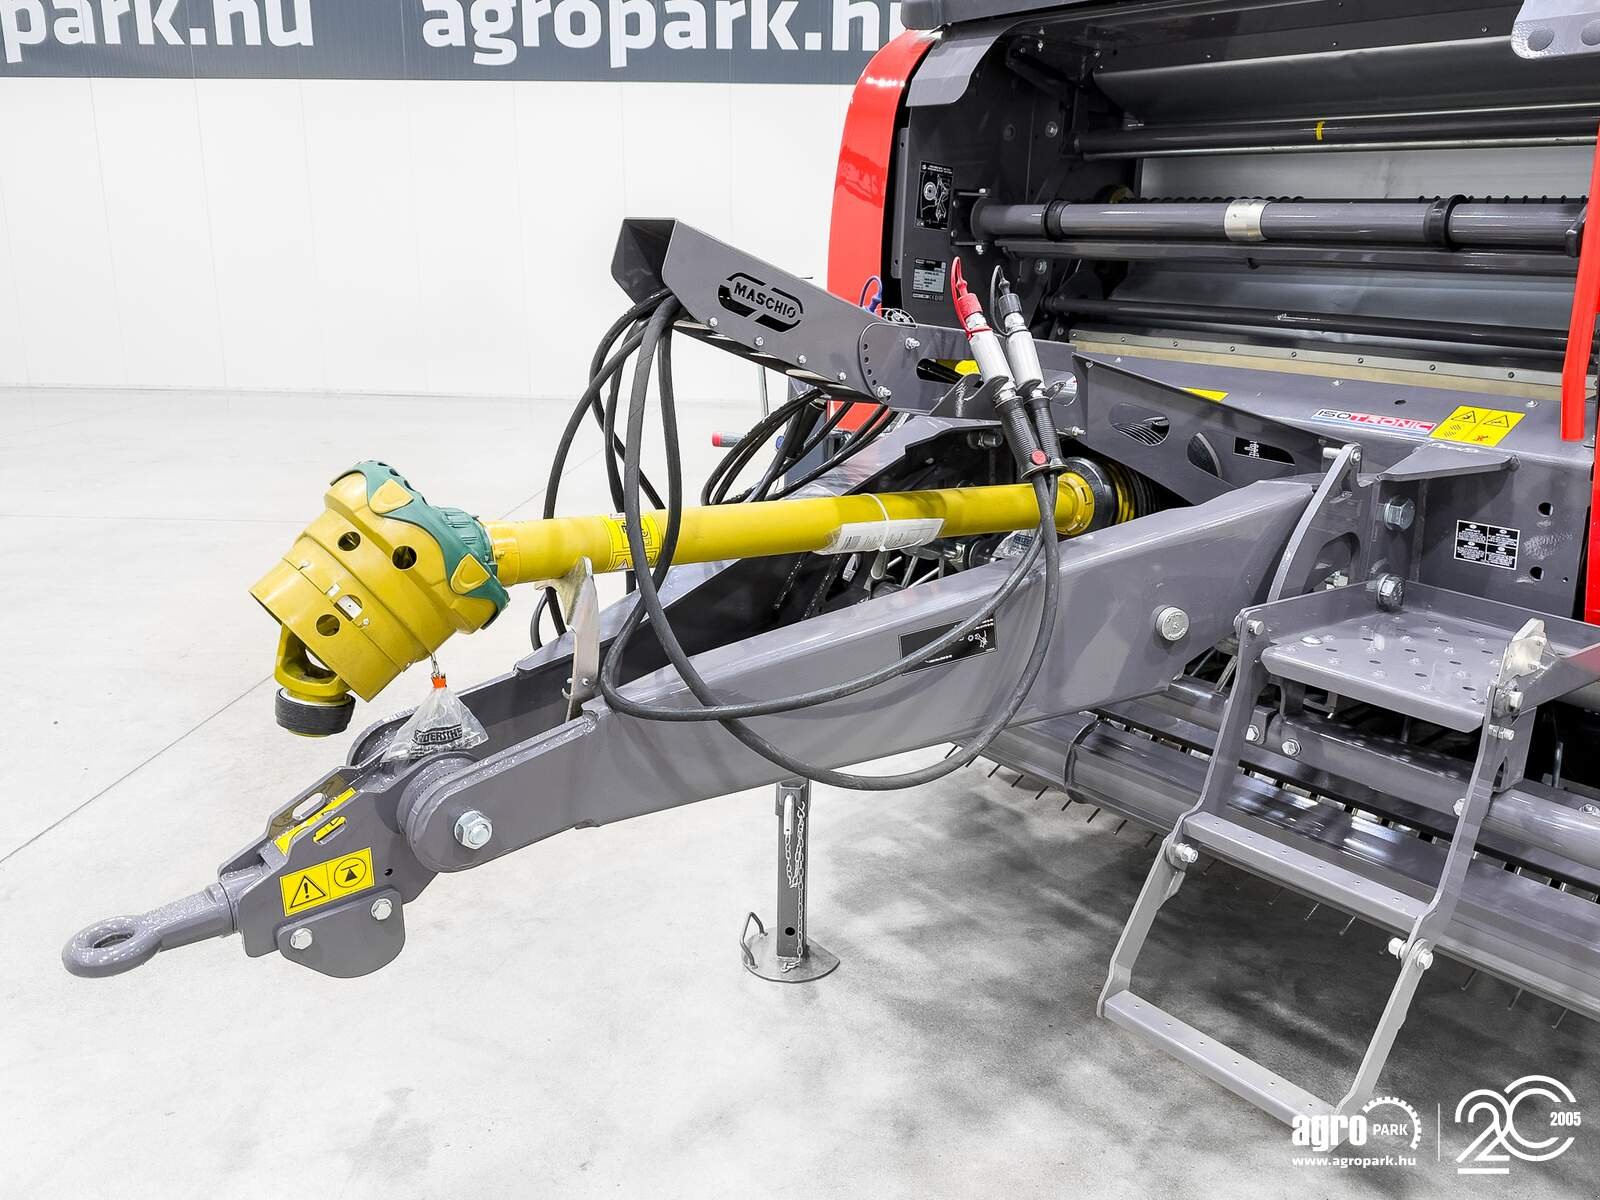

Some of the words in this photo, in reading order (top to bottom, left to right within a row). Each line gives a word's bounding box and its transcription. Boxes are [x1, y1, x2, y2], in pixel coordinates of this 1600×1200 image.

[422, 0, 906, 69] agropark.h
[733, 281, 797, 319] MASCHIO
[1317, 410, 1436, 431] ISOTRONIC
